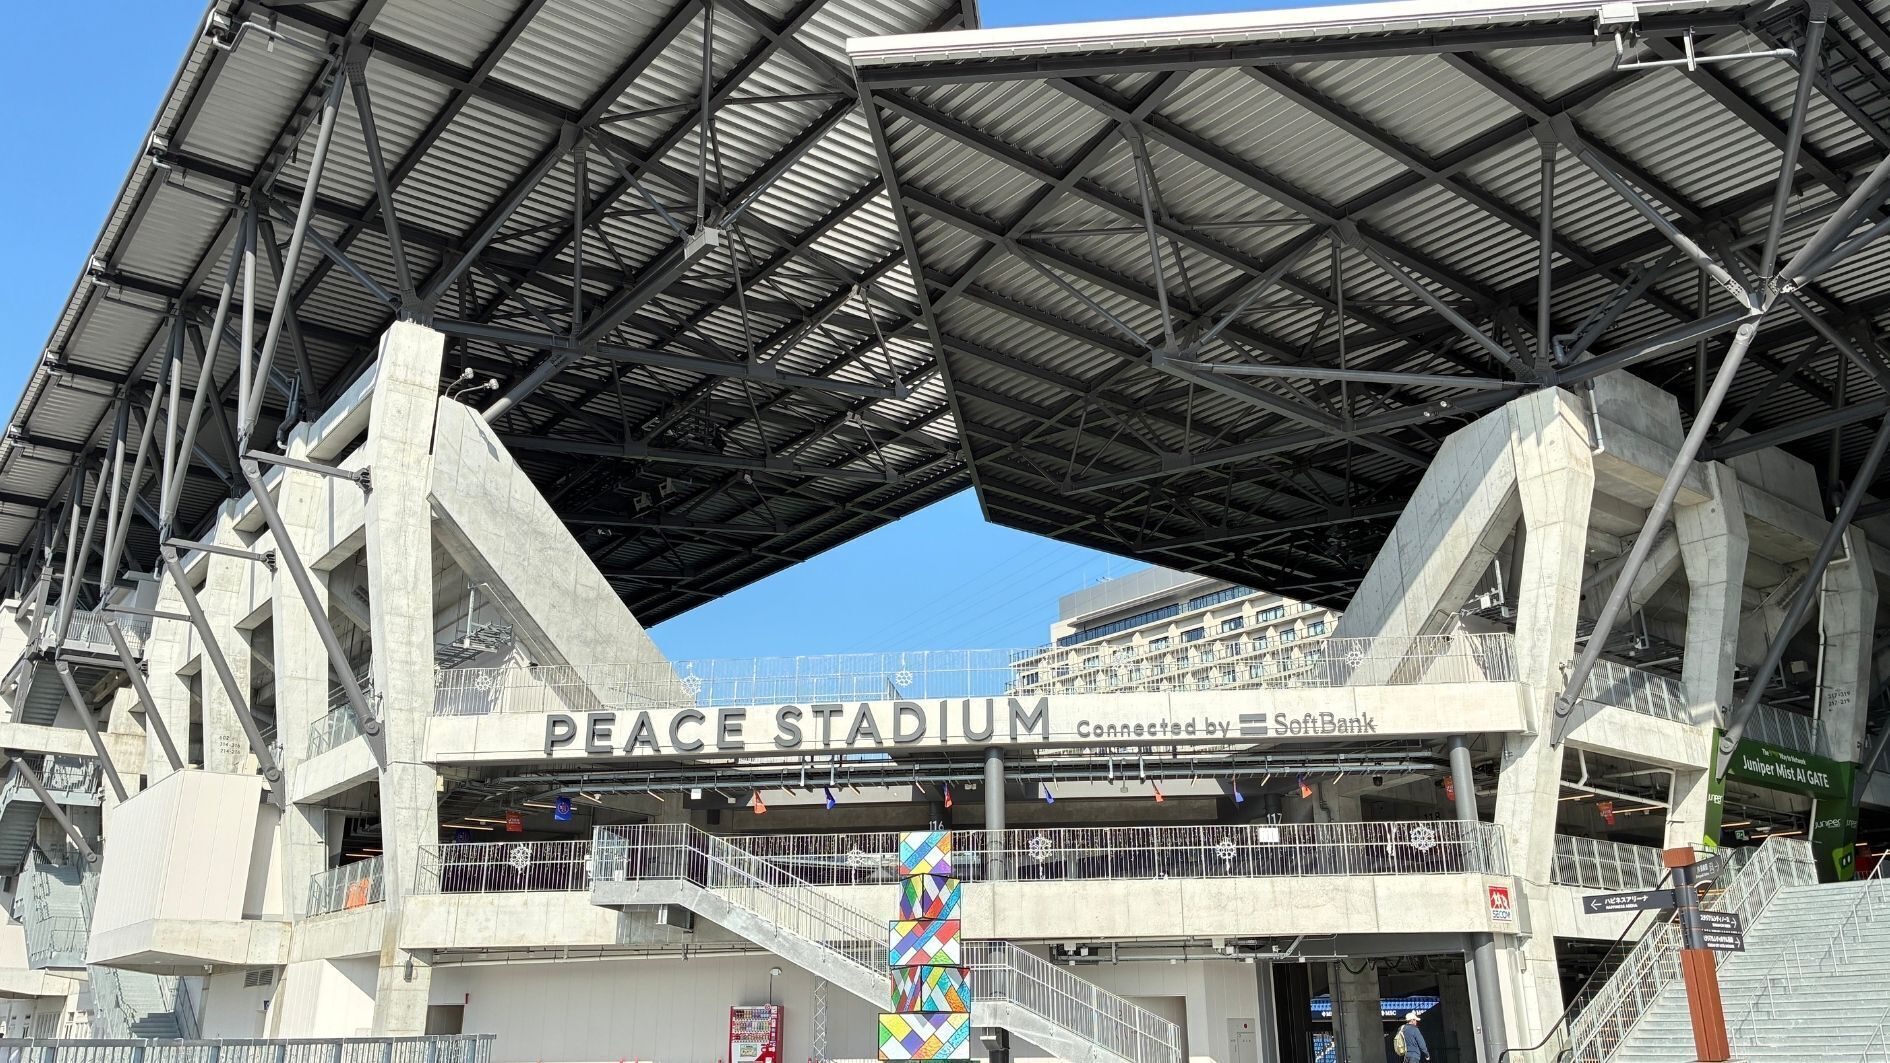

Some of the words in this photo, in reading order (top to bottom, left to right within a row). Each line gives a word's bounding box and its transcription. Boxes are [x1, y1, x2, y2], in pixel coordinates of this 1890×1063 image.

[544, 707, 748, 755] PEACE
[773, 696, 1050, 750] STADIUM
[1076, 717, 1197, 738] Connected
[1205, 717, 1231, 738] by
[1274, 711, 1377, 735] SoftBank
[1743, 755, 1774, 777] Juniper
[1775, 762, 1796, 780] Mist
[1796, 768, 1806, 783] AI
[1807, 770, 1830, 788] GATE
[929, 820, 945, 831] 116
[1266, 813, 1282, 825] 117
[1492, 909, 1511, 919] SECOM
